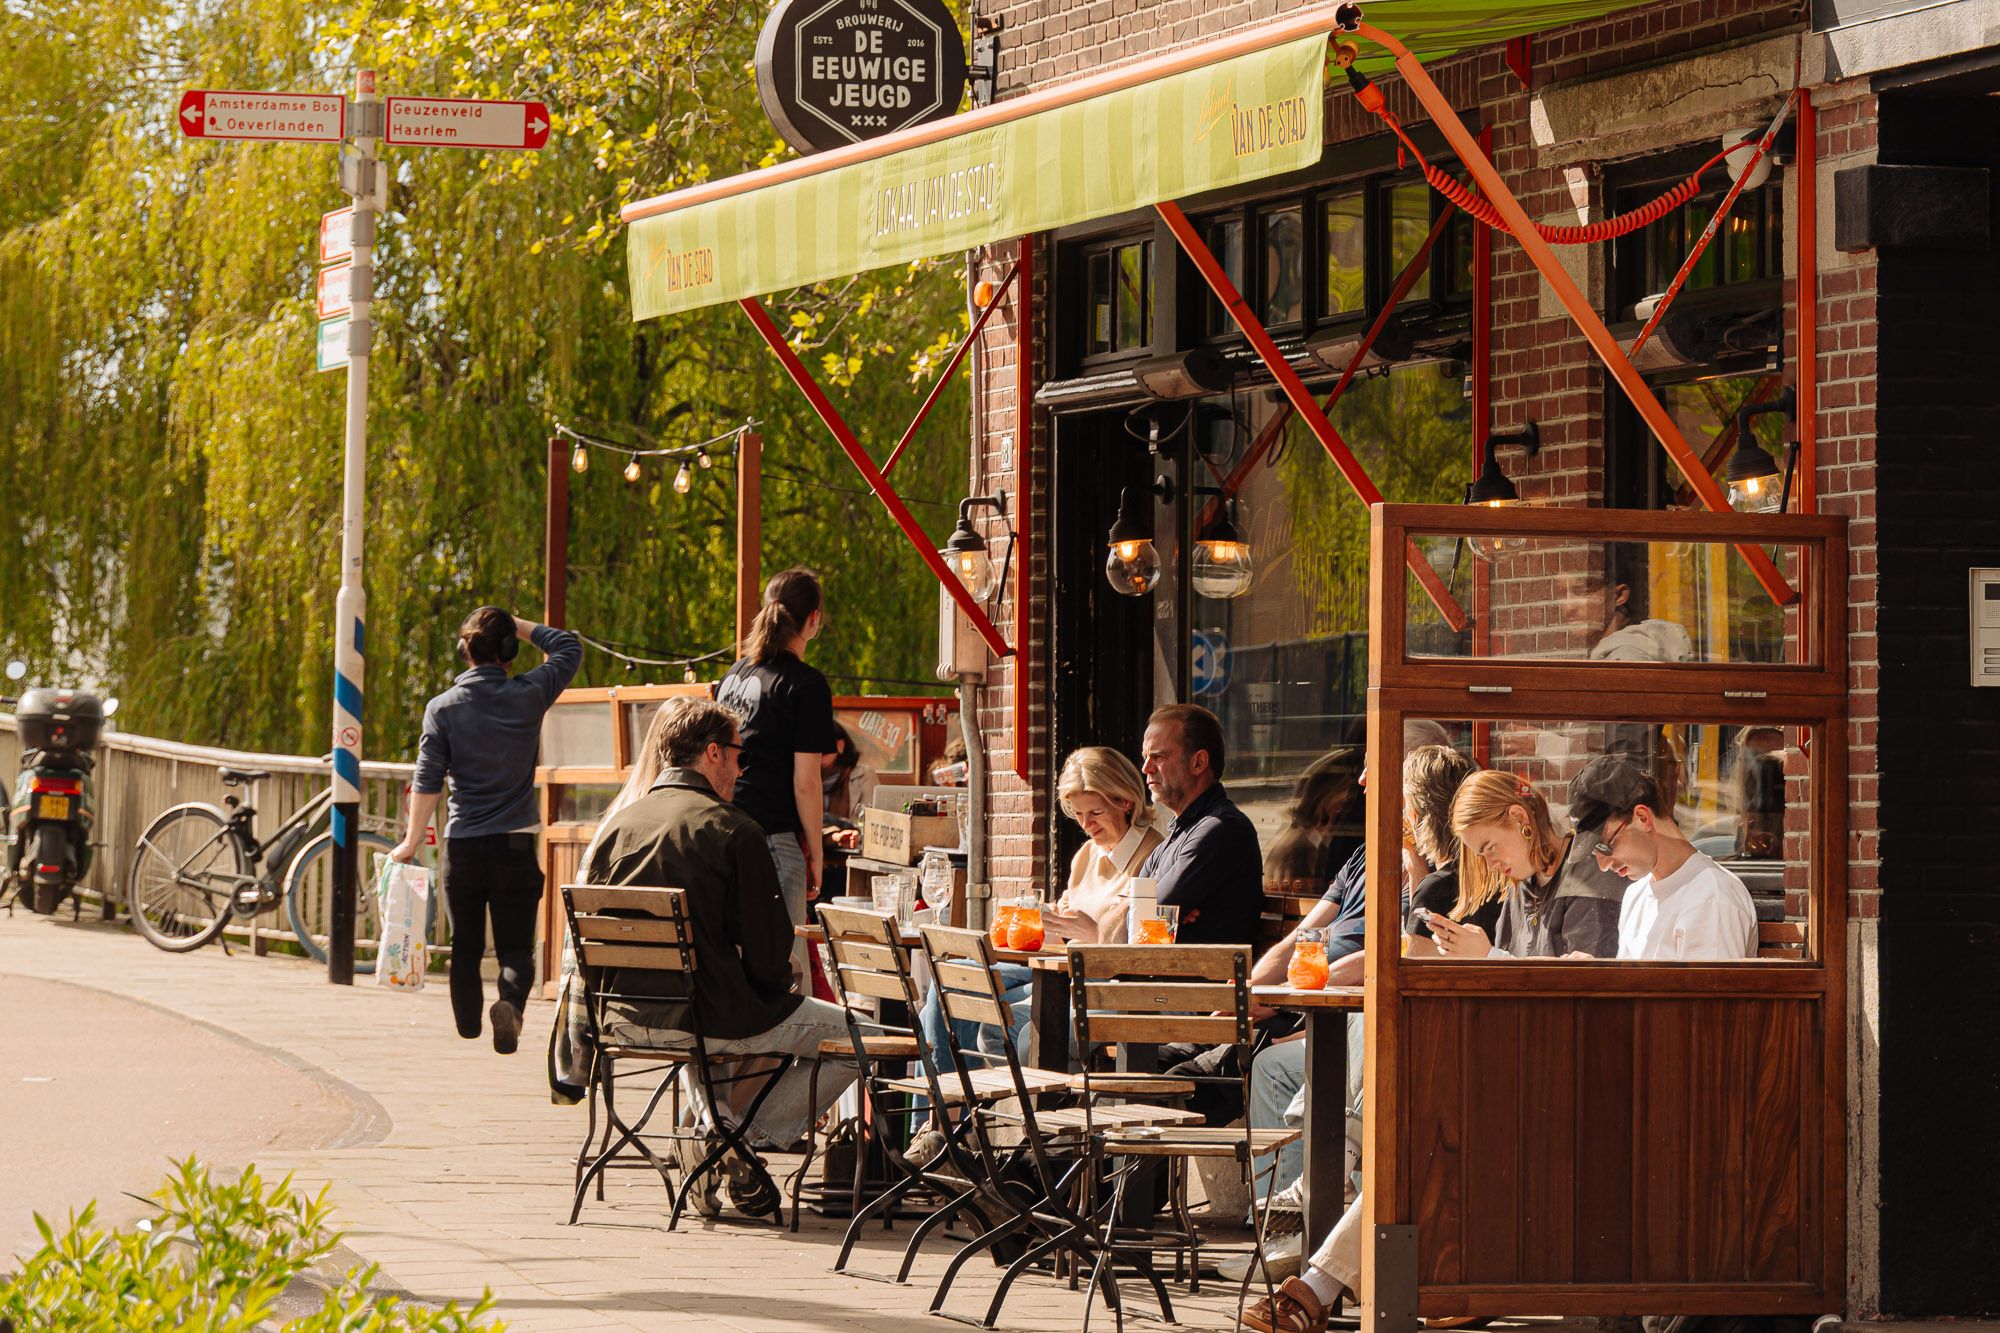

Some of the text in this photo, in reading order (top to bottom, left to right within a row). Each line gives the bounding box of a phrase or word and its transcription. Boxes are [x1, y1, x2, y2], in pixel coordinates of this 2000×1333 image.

[835, 13, 904, 33] BROUWERIJ
[855, 30, 883, 54] DE
[907, 39, 925, 48] 2016
[812, 56, 926, 83] EEUWIGE
[208, 98, 338, 113] Amsterdamse Bos
[829, 84, 911, 109] JEUGD
[393, 103, 483, 118] Geuzenveld
[227, 117, 325, 132] Oeverlanden
[393, 124, 458, 137] Haarlem
[1231, 96, 1307, 156] VAN DE STAD
[876, 160, 995, 237] LOKAAL VAN DE STAD
[666, 249, 681, 292] VAN
[683, 252, 693, 288] DE
[695, 248, 713, 286] STAD
[870, 823, 904, 849] THE POP SHOP
